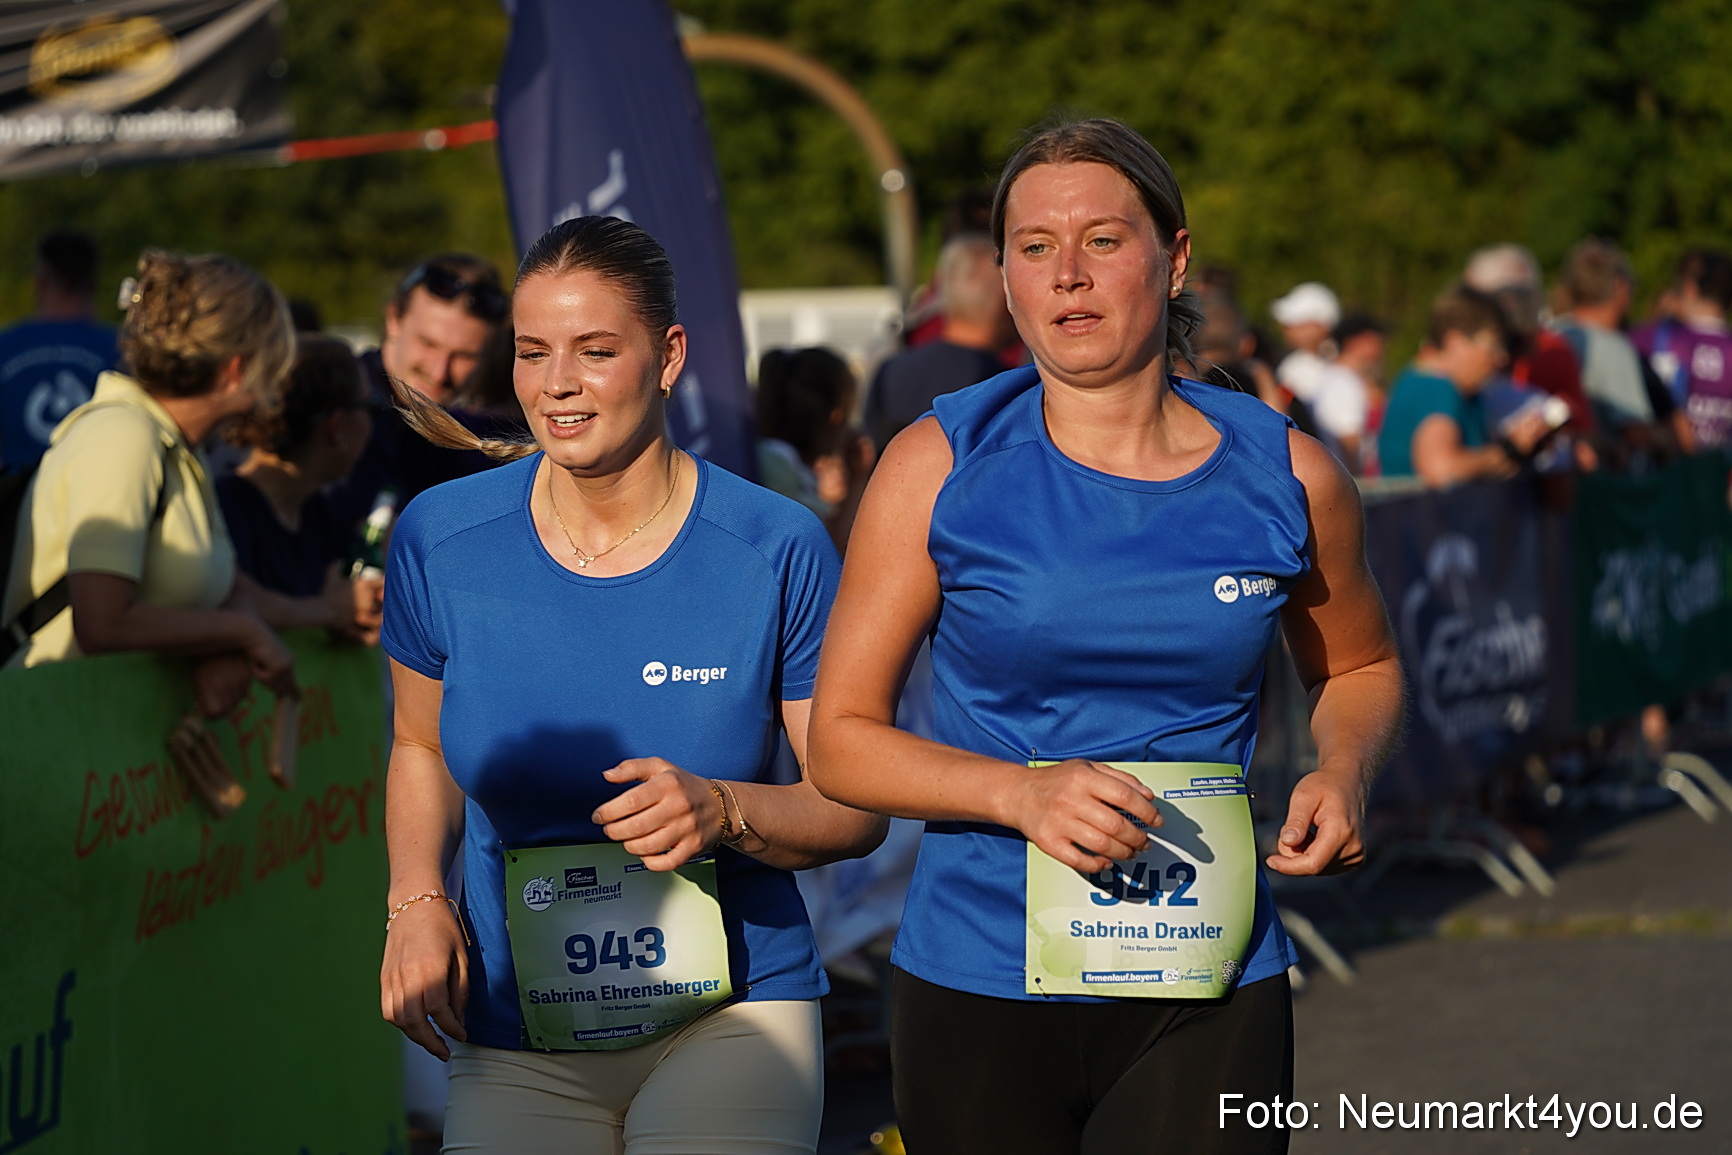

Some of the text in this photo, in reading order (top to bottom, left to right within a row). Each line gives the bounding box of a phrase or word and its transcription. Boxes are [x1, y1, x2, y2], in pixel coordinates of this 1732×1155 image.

[671, 665, 728, 685] Berger
[558, 881, 622, 901] Firmenlauf
[1090, 862, 1199, 907] 942
[584, 892, 622, 904] neumarkt
[1070, 920, 1222, 939] Sabrina Draxler
[564, 926, 667, 975] 943
[1085, 973, 1159, 983] firmenlauf.bayern
[528, 979, 721, 1005] Sabrina Ehrensberger
[576, 1027, 639, 1039] firmenlauf.bayern
